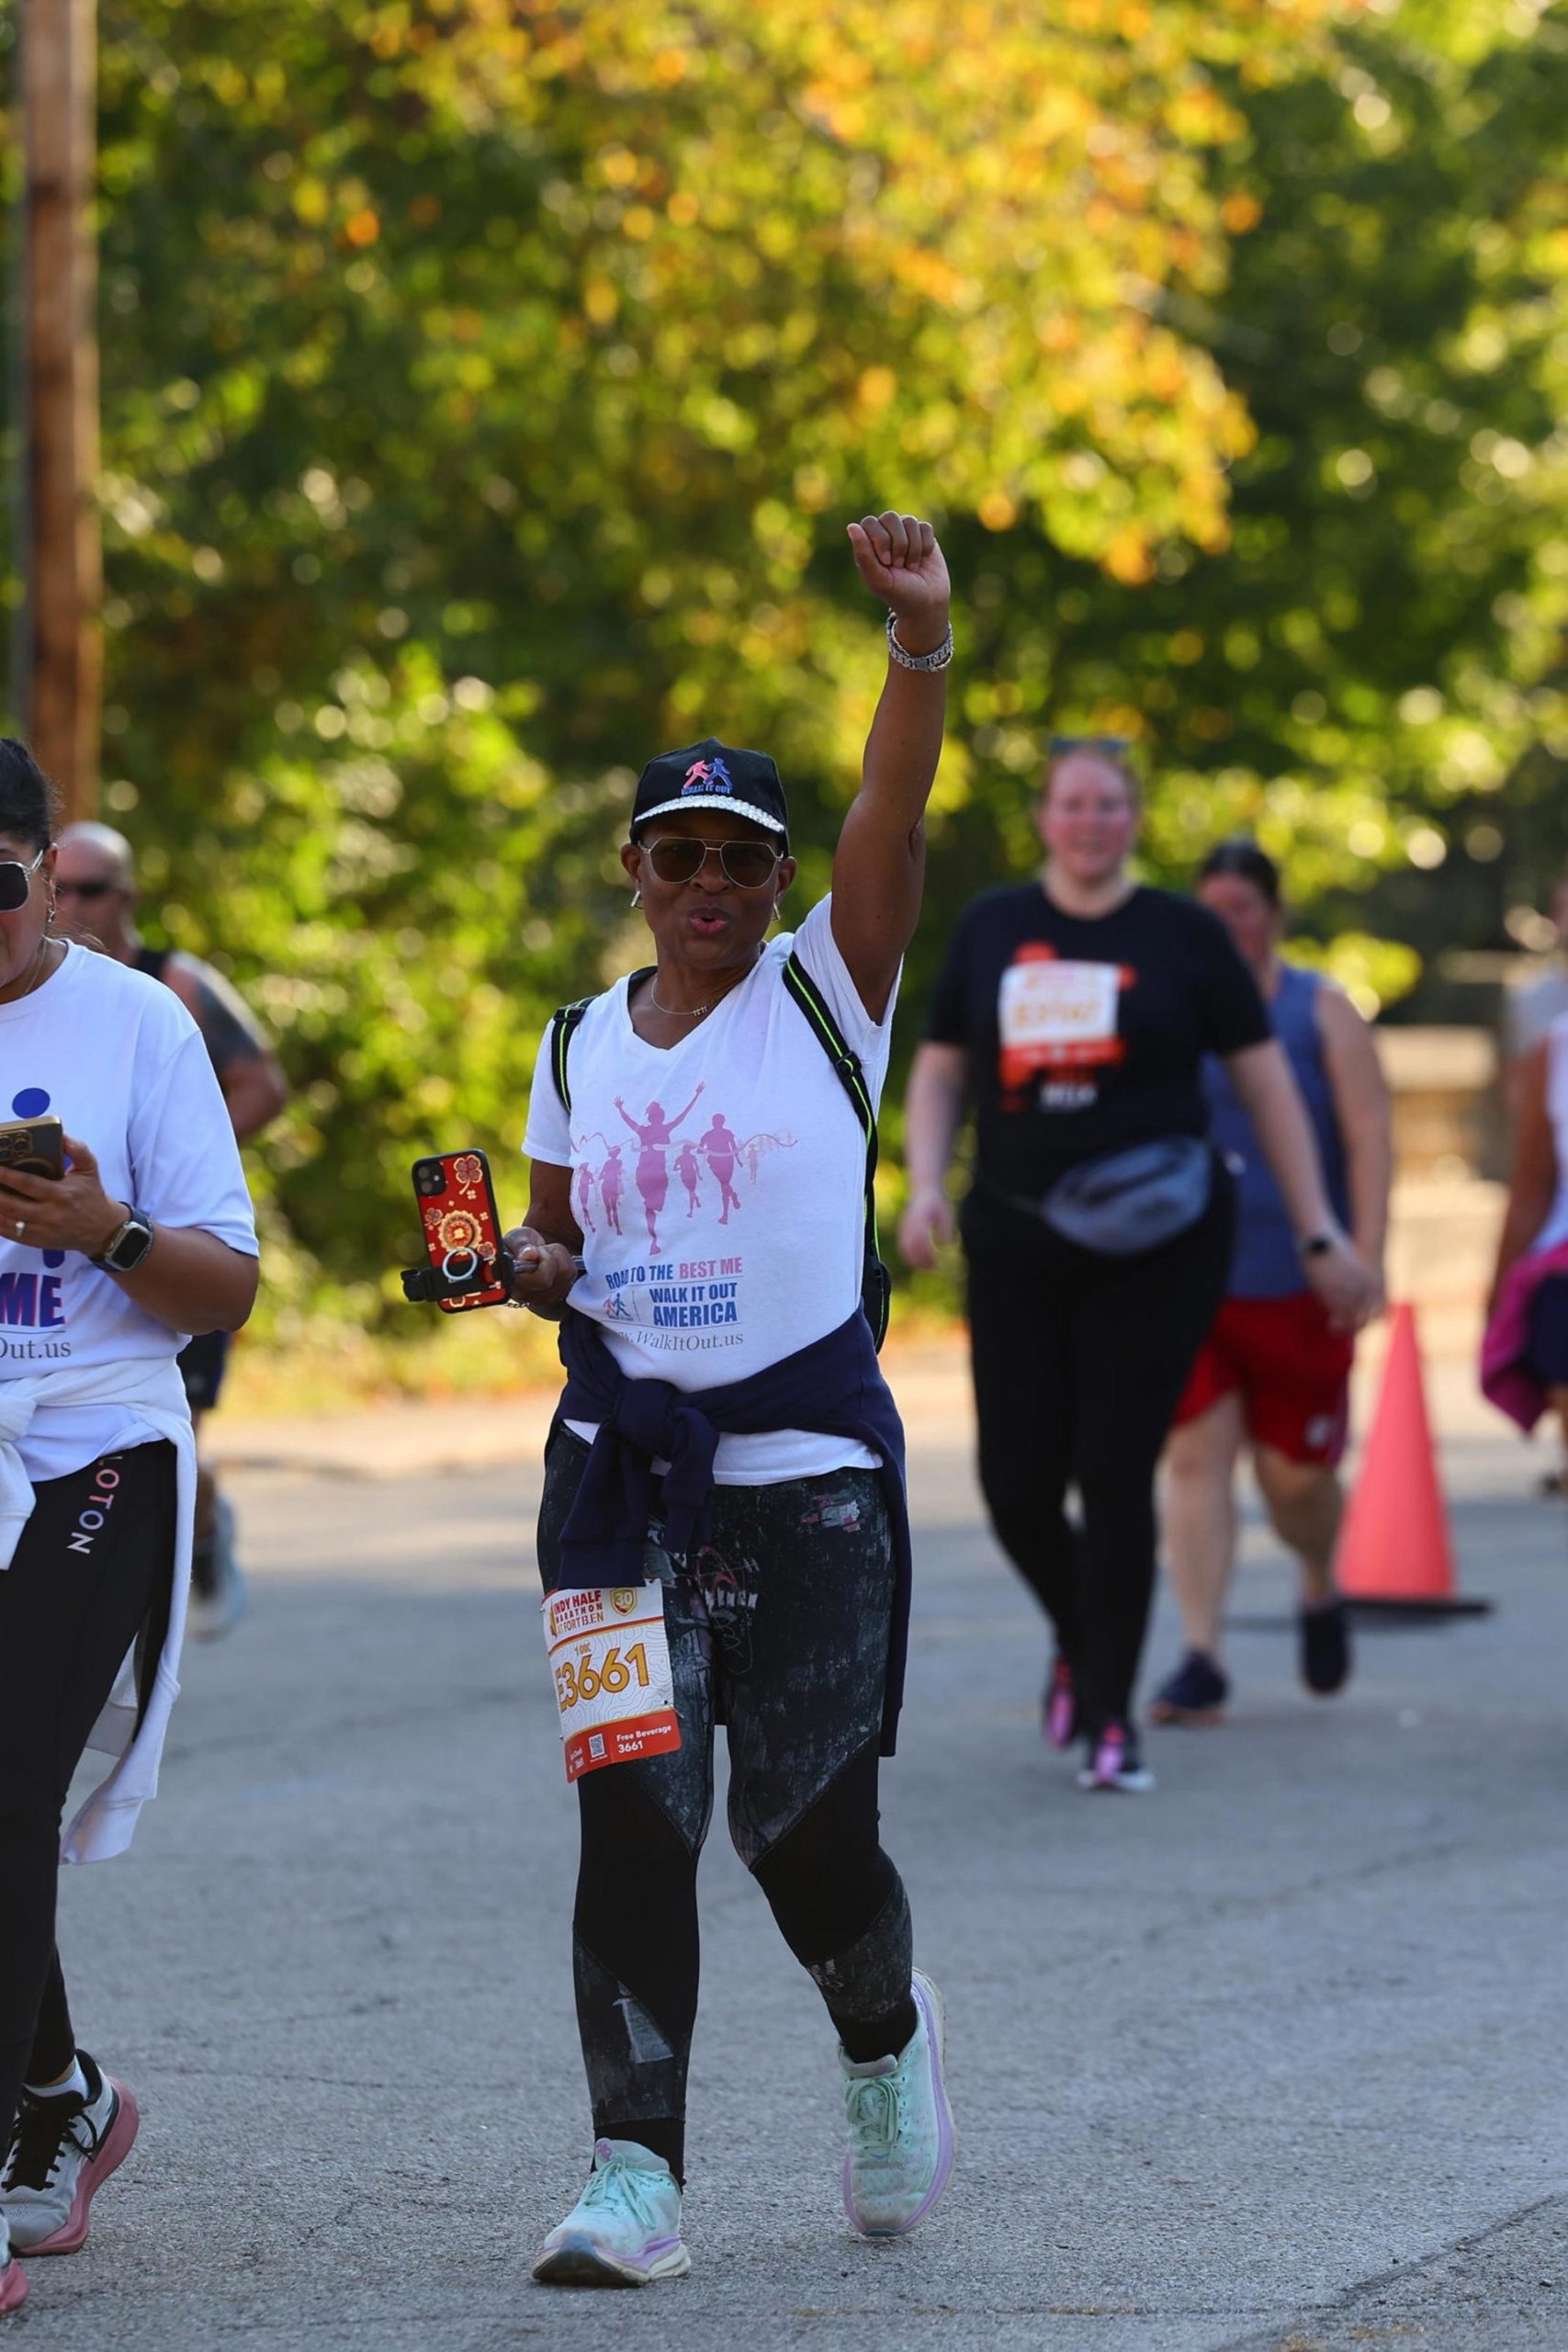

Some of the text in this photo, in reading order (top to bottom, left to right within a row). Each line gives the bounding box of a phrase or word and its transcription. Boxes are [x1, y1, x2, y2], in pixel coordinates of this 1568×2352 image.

[631, 1266, 645, 1283] TO
[649, 1264, 673, 1281] THE
[679, 1260, 716, 1279] BEST
[720, 1257, 742, 1274] ME
[649, 1283, 738, 1303] WALK IT OUT
[653, 1301, 738, 1328] AMERICA
[572, 1590, 602, 1608] HALF
[616, 1591, 633, 1608] 30
[556, 1602, 603, 1623] MARATHON
[563, 1617, 581, 1632] FORT
[555, 1643, 649, 1713] E3661
[616, 1725, 671, 1742] Free Beverage
[617, 1740, 643, 1754] 3661
